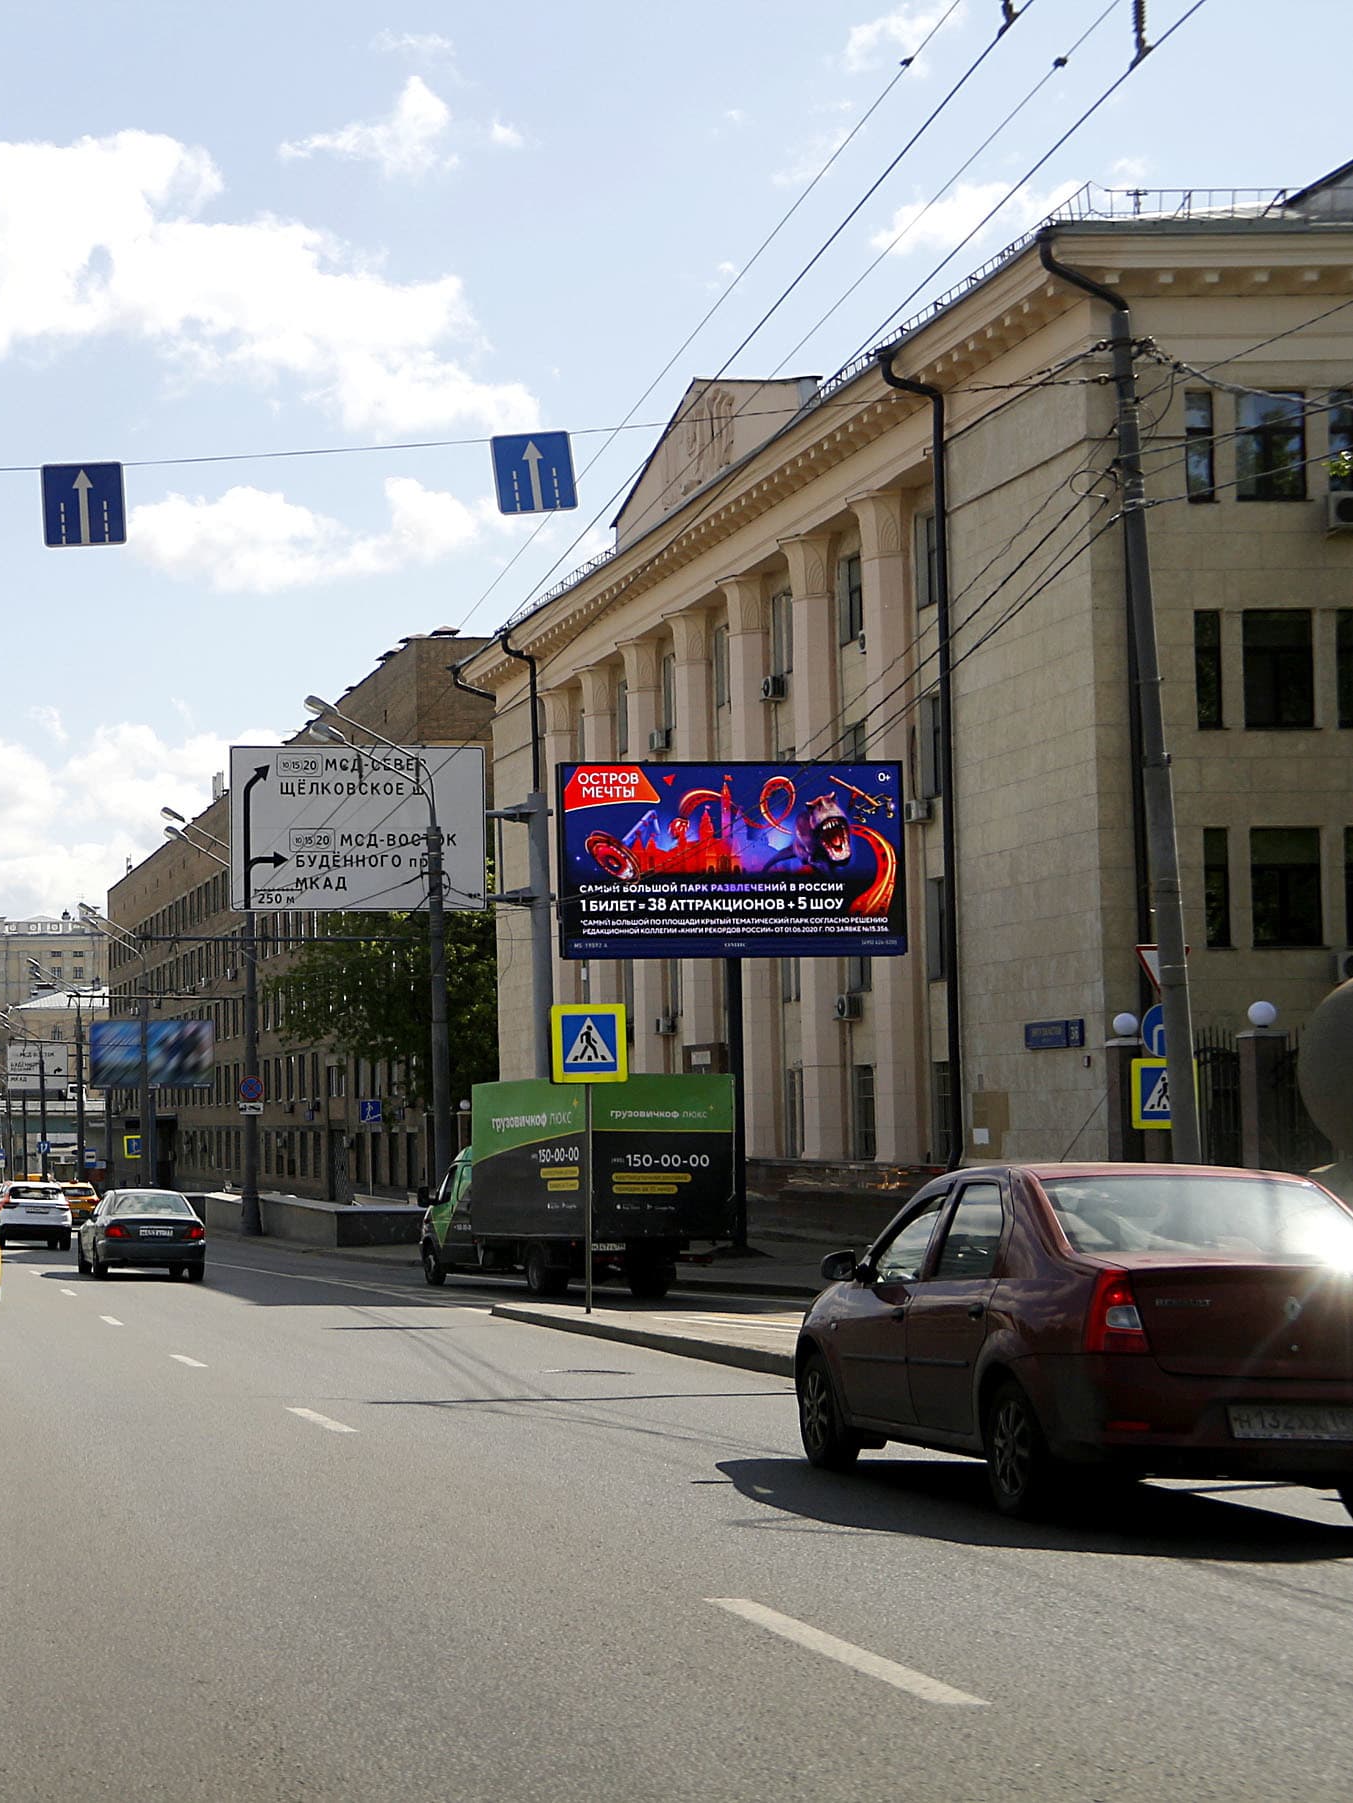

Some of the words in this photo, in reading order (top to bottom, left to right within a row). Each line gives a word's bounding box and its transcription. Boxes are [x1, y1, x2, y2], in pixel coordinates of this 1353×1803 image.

[303, 760, 317, 770] 20
[578, 772, 639, 784] ОСТРОВ
[878, 773, 891, 782] 0+
[280, 778, 405, 796] ЩЁЛКОВСКОЕ
[582, 786, 635, 798] МЕЧТЫ
[316, 835, 329, 845] 20
[340, 833, 456, 847] МСД-ВОСК
[295, 852, 401, 869] БУДЁННОГО
[295, 877, 347, 891] МКАД
[579, 883, 620, 893] САМЫЙ
[623, 882, 677, 893] БОЛЬШОЙ
[680, 884, 708, 893] ПАРК
[710, 881, 787, 892] РАЗВЛЕЧЕНИЙ
[790, 883, 796, 891] В
[258, 893, 282, 904] 250
[286, 896, 295, 904] м
[580, 900, 587, 911] 1
[590, 900, 636, 911] БИЛЕТ
[648, 898, 666, 911] 38
[670, 898, 785, 912] АТТРАКЦИОНОВ
[798, 896, 807, 910] 5
[810, 898, 844, 910] ШОУ
[610, 1110, 679, 1119] грузовичкоф
[682, 1111, 708, 1119] люкс
[492, 1112, 547, 1132] грузовичкоф
[549, 1111, 572, 1125] люкс
[538, 1146, 579, 1163] 150-00-00
[625, 1154, 710, 1167] 150-00-00
